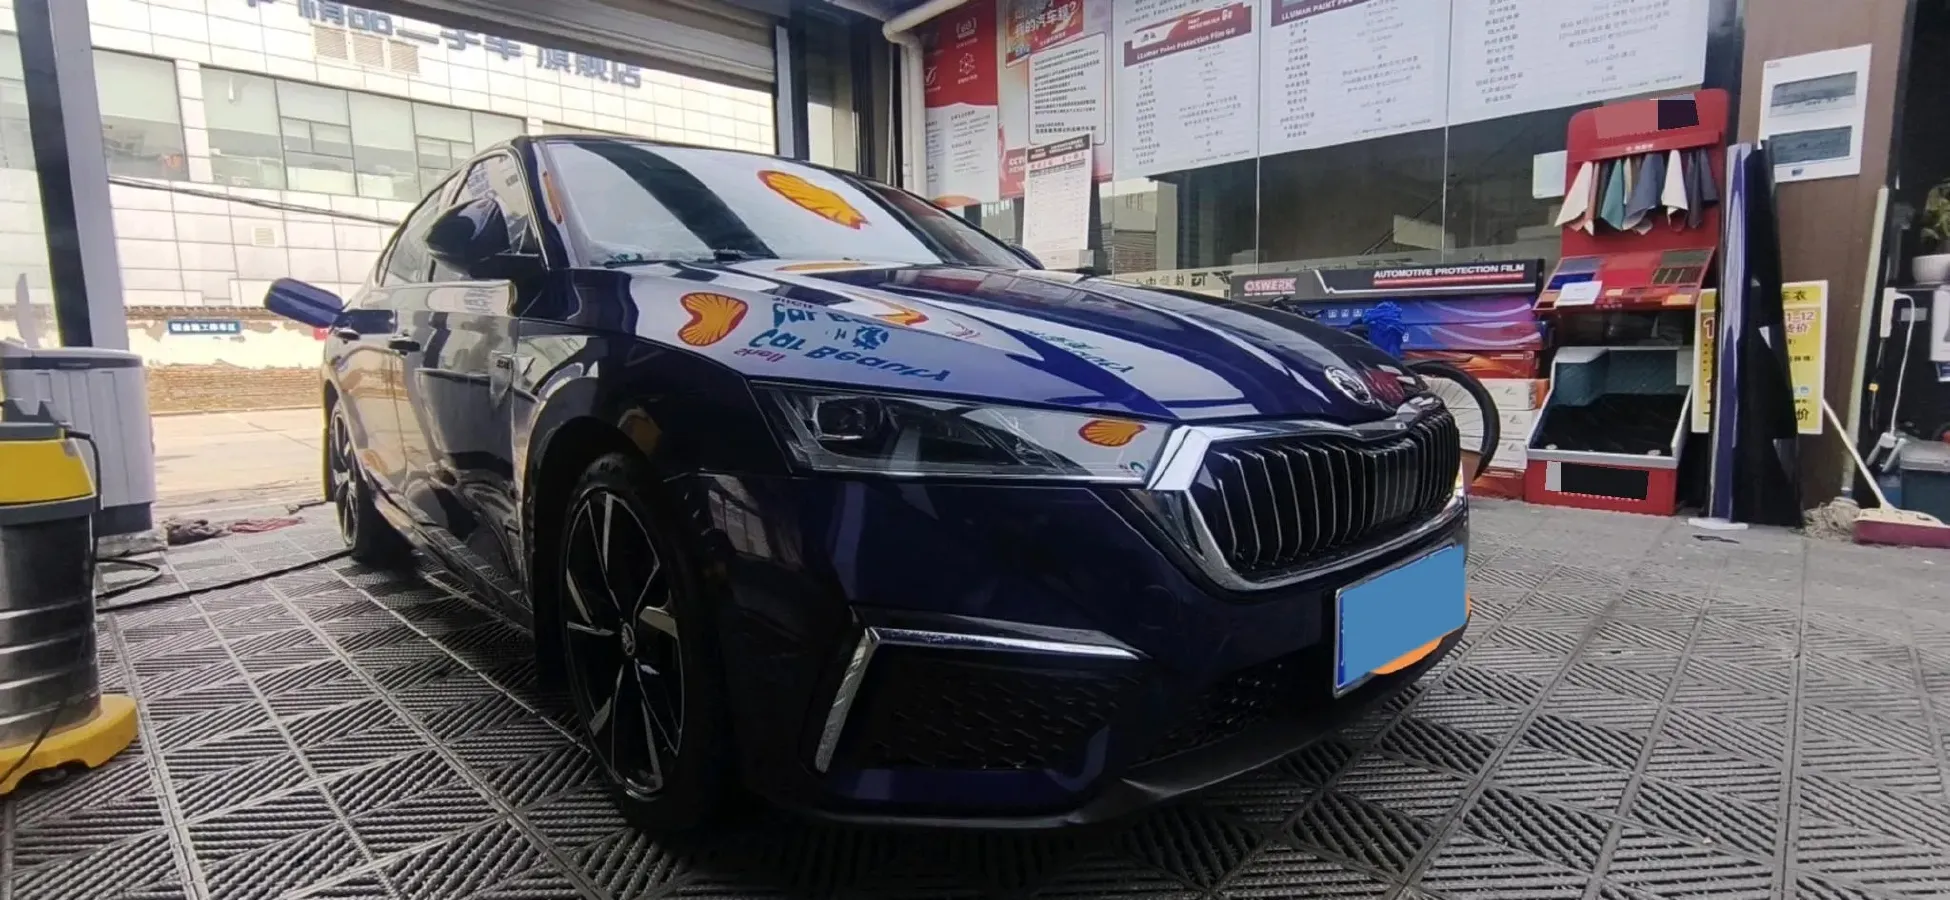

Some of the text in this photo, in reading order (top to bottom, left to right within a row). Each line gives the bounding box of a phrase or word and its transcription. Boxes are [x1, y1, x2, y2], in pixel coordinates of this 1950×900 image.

[1374, 263, 1525, 279] AUTOMOTIVE PROTECTION FILM
